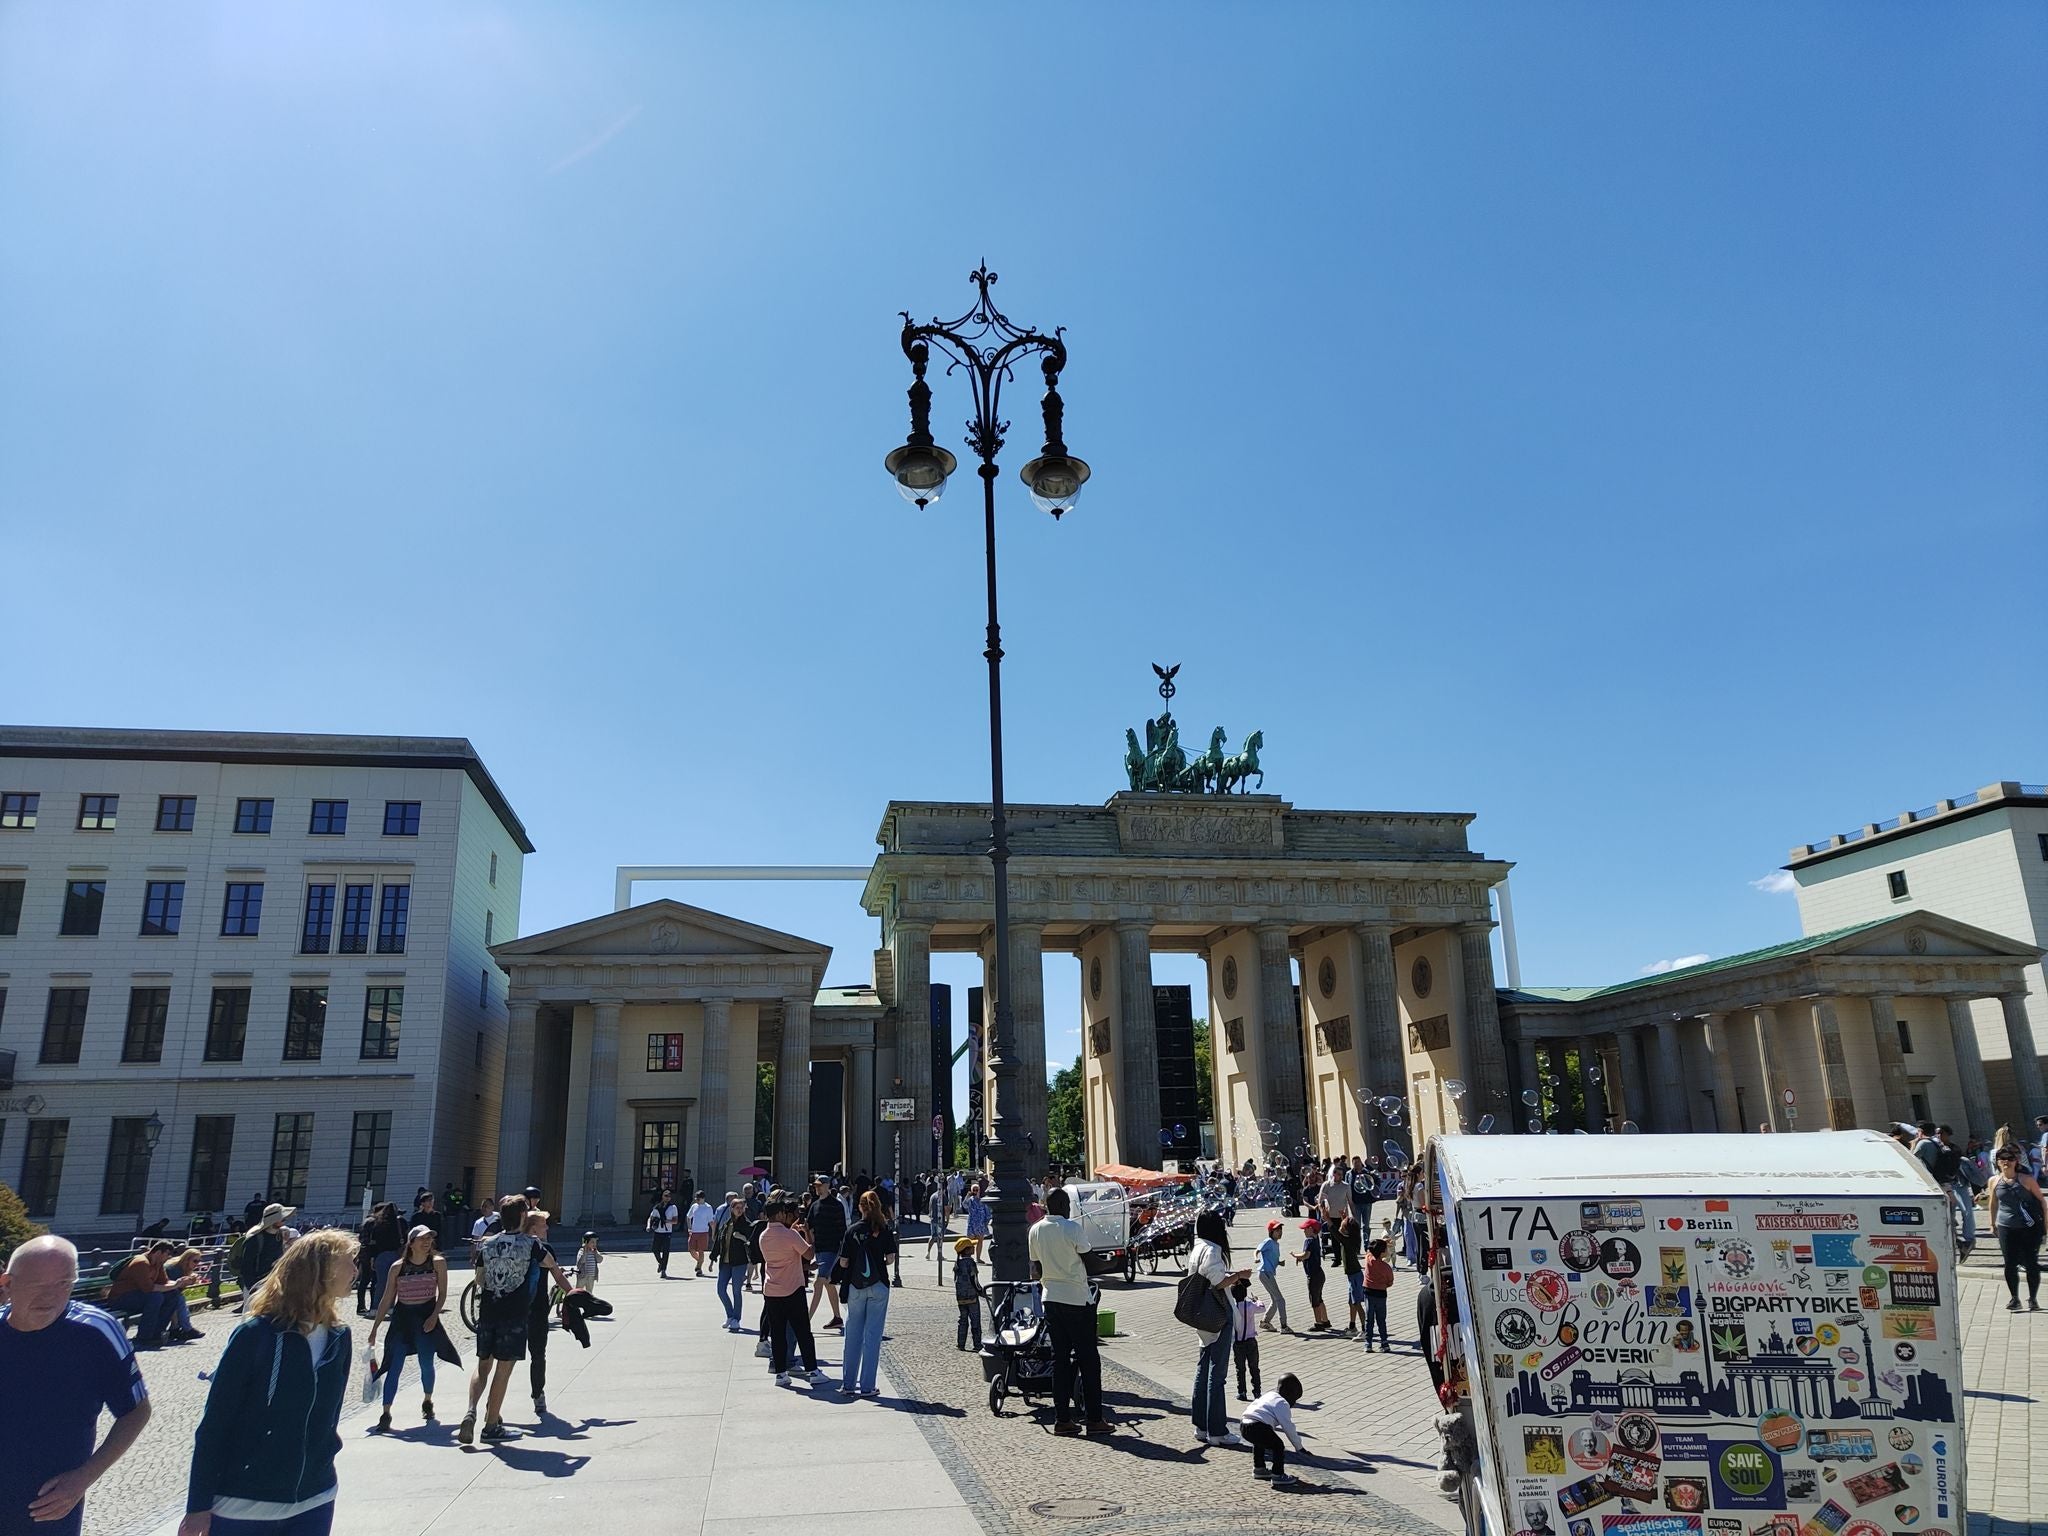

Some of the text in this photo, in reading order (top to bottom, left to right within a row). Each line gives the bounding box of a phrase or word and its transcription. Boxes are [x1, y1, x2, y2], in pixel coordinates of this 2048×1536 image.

[1478, 1206, 1558, 1241] 17A
[1659, 1218, 1733, 1230] I Berlin
[1757, 1215, 1839, 1229] KAISERSLAUTERN
[1502, 1273, 1506, 1281] I
[1893, 1273, 1934, 1285] DER HARTE
[1895, 1285, 1936, 1300] NORDEN
[1711, 1295, 1860, 1314] BIGPARTYBIKE
[1507, 1308, 1525, 1316] SOCIAL
[1523, 1313, 1535, 1328] CLUB
[1534, 1299, 1672, 1348] Berlin
[1709, 1318, 1745, 1326] Legalize
[1506, 1336, 1533, 1349] STUTTGART
[1552, 1350, 1580, 1373] Sirius
[1523, 1427, 1562, 1435] PFALZ
[1780, 1423, 1802, 1436] PEACH
[1611, 1452, 1637, 1465] BETZE
[1637, 1460, 1659, 1471] FANS
[1727, 1453, 1763, 1468] SAVE
[1729, 1469, 1765, 1486] SOIL
[1798, 1469, 1816, 1480] 8964
[1936, 1458, 1949, 1501] EUROPE
[1617, 1518, 1684, 1532] sexistische
[1709, 1520, 1740, 1528] EUROPA
